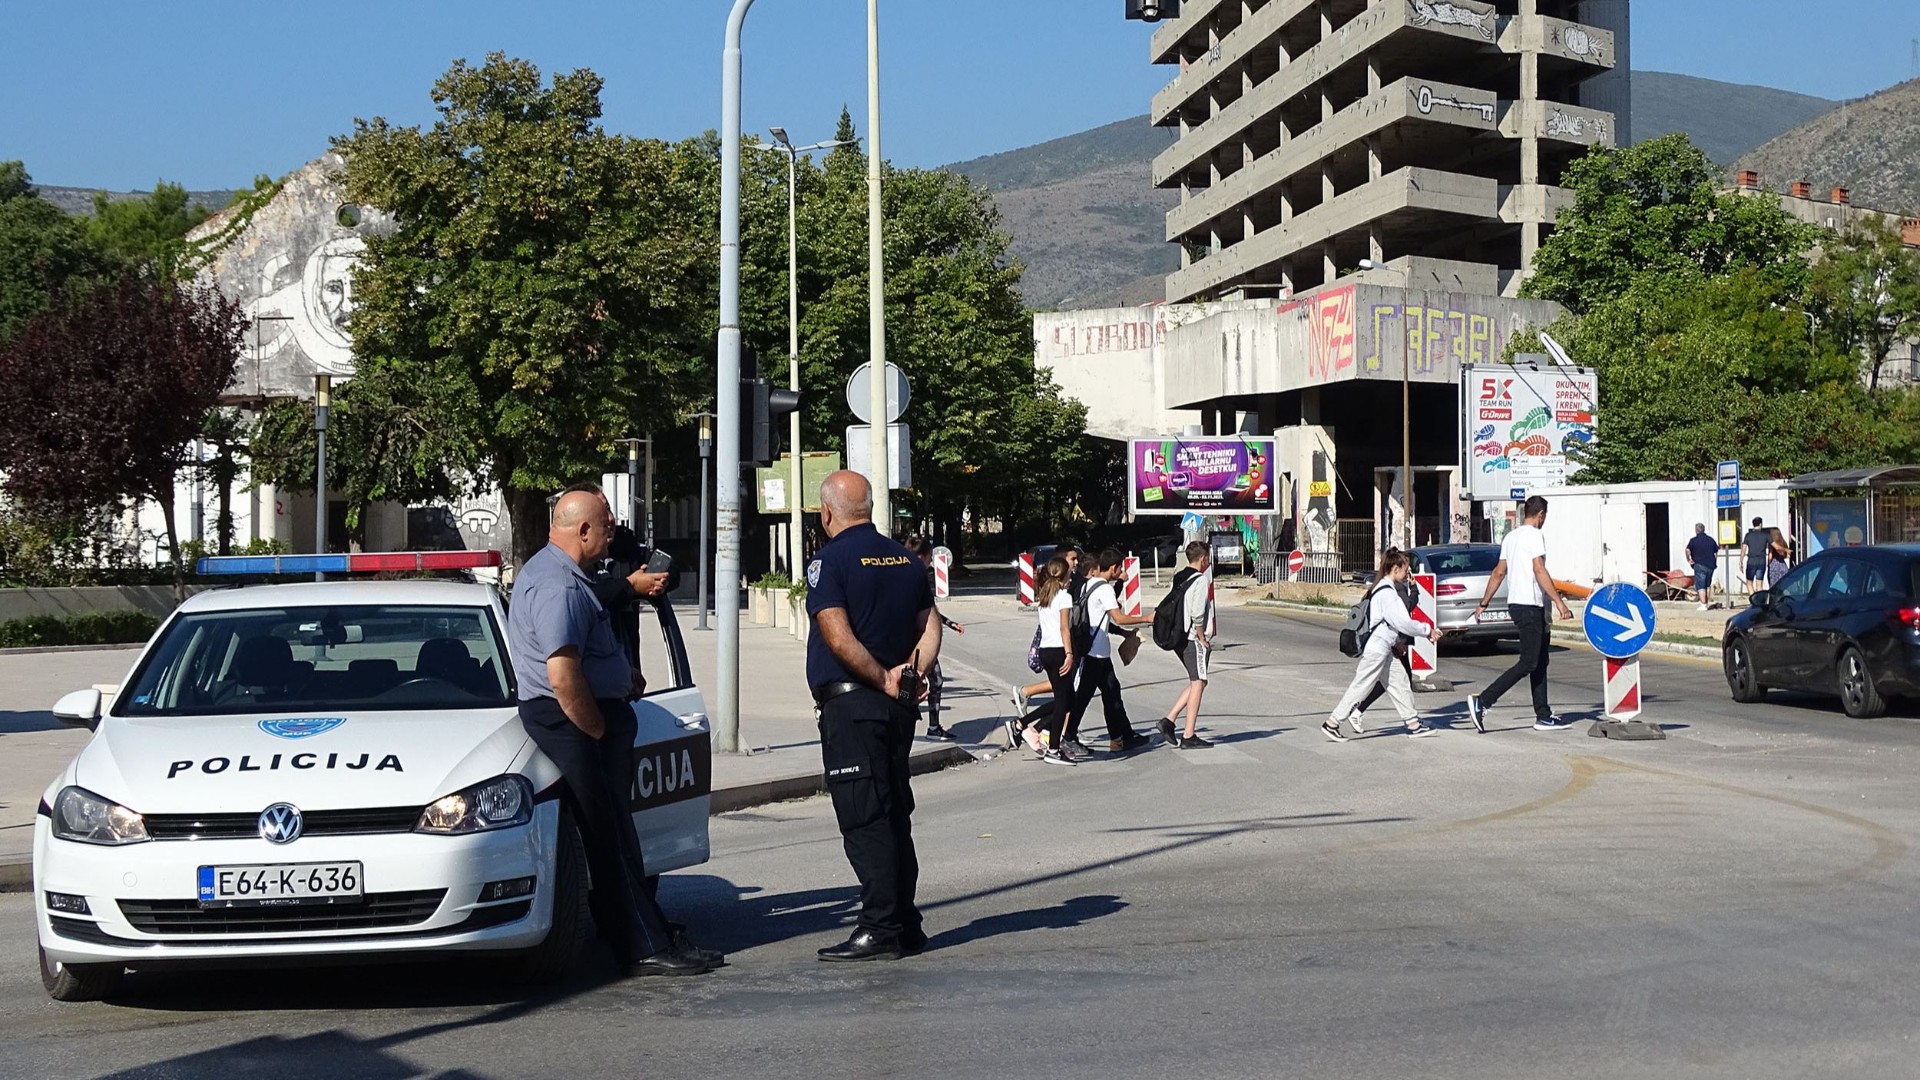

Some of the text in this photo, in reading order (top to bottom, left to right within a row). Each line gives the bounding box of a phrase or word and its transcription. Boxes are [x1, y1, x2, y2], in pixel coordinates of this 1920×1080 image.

[1556, 381, 1576, 389] OKUPI
[1556, 391, 1580, 399] SPREMI
[1560, 401, 1583, 409] KRENI!
[1203, 449, 1236, 459] TEHNIKU
[1189, 457, 1231, 467] JUBILARNU
[1198, 464, 1237, 474] DESETKU!
[861, 556, 912, 566] POLICIJA
[167, 752, 403, 779] POLICIJA
[201, 867, 356, 896] BIH E64-K-636
